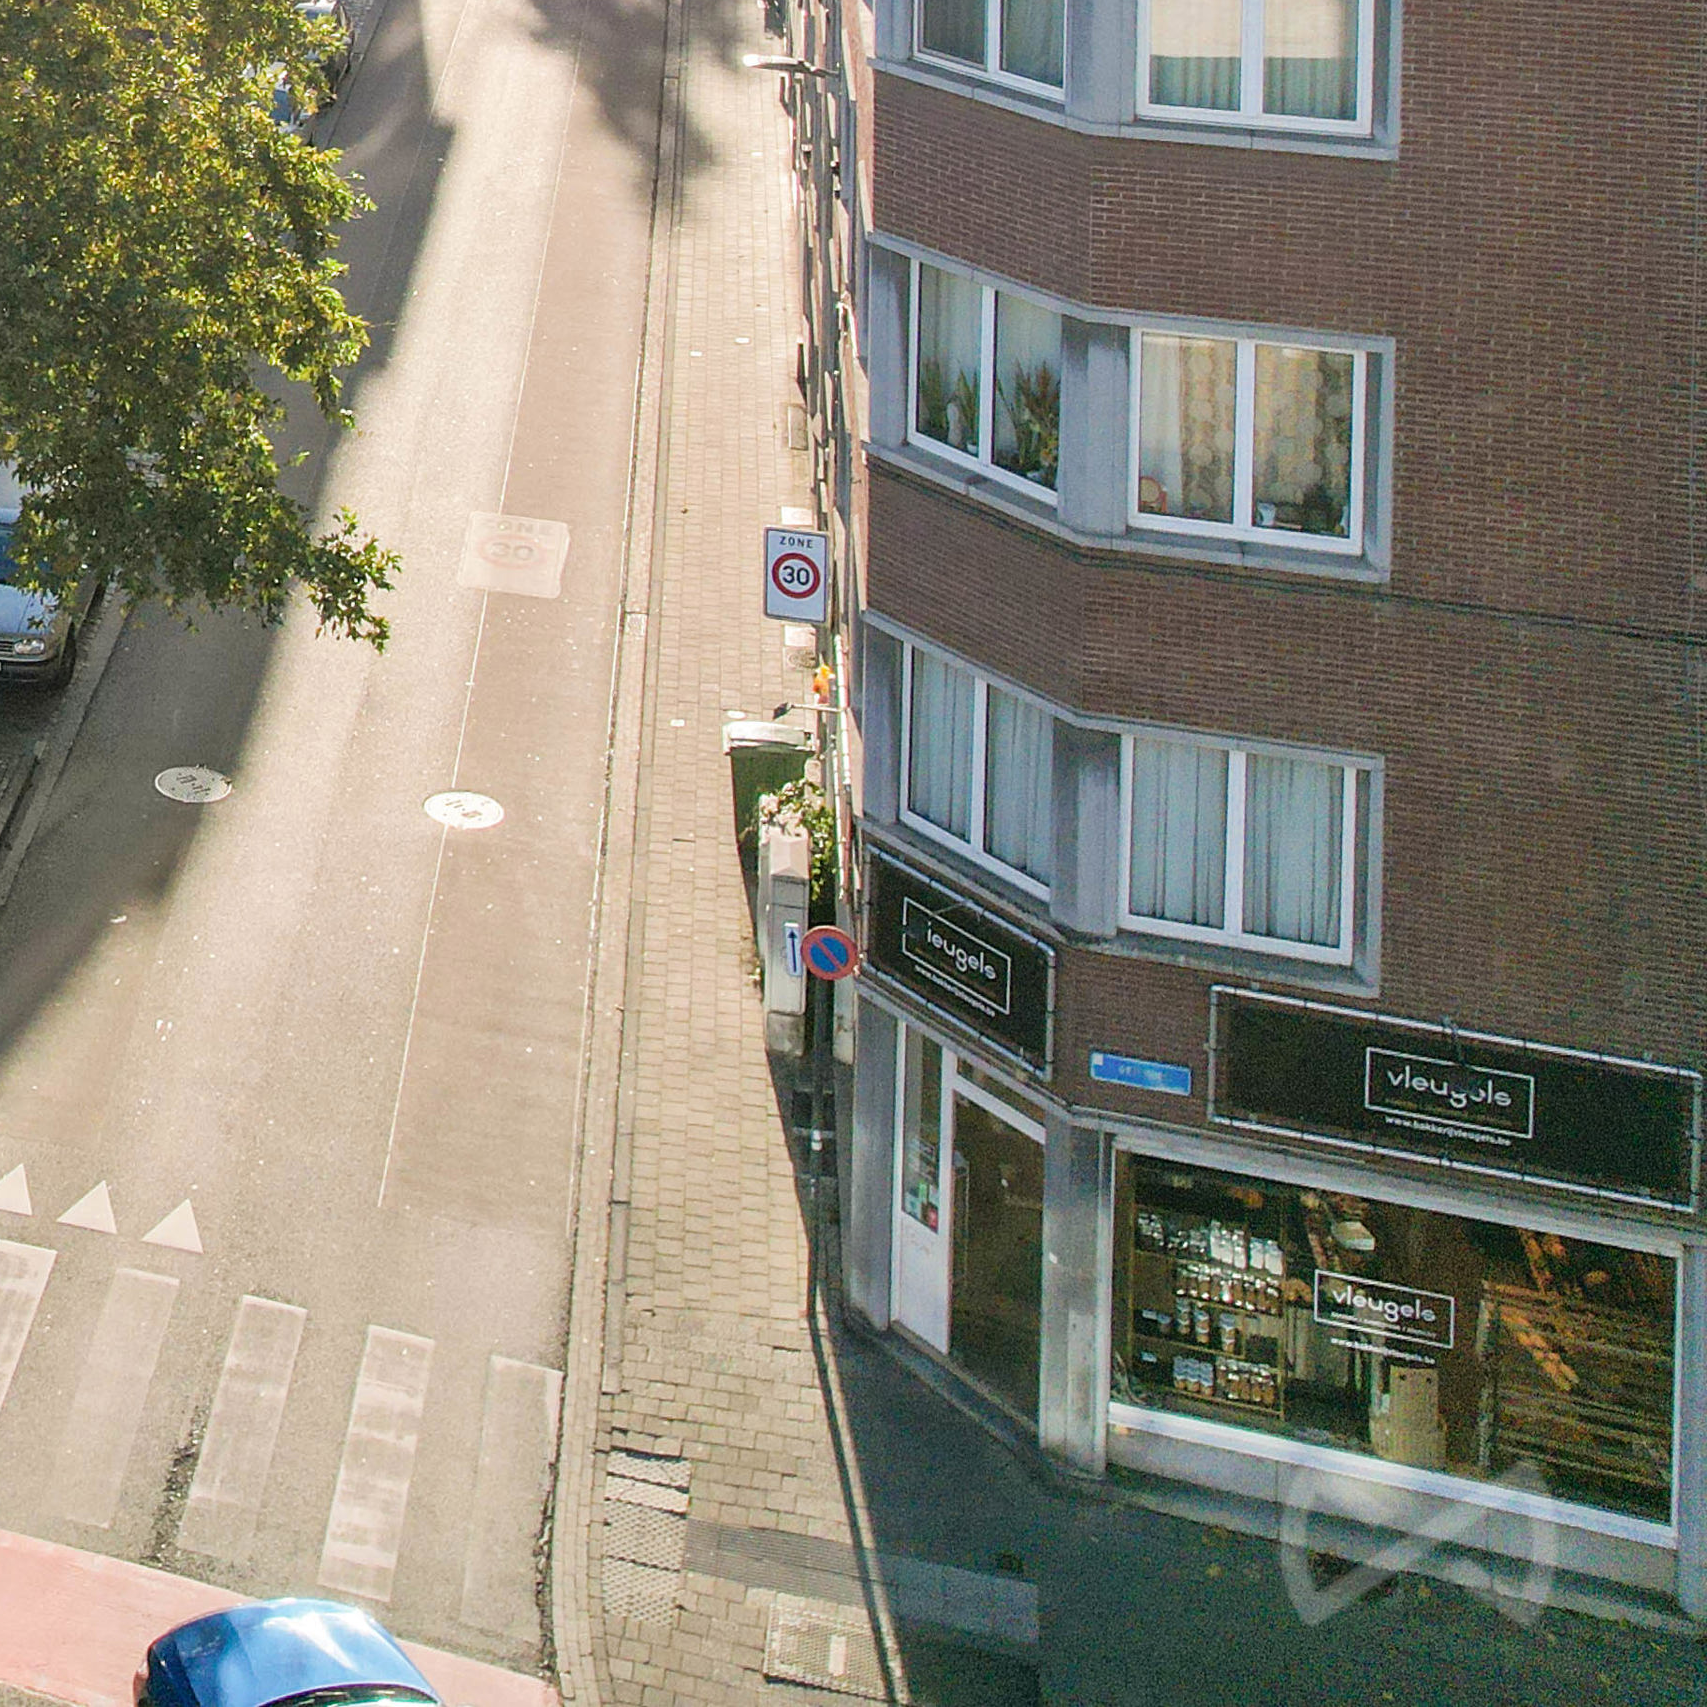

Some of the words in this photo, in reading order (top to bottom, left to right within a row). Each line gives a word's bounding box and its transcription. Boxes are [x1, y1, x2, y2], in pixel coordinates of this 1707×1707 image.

[779, 536, 813, 548] ZONE
[782, 565, 810, 586] 30
[925, 920, 997, 980] leugels
[1331, 1284, 1437, 1323] vleugels
